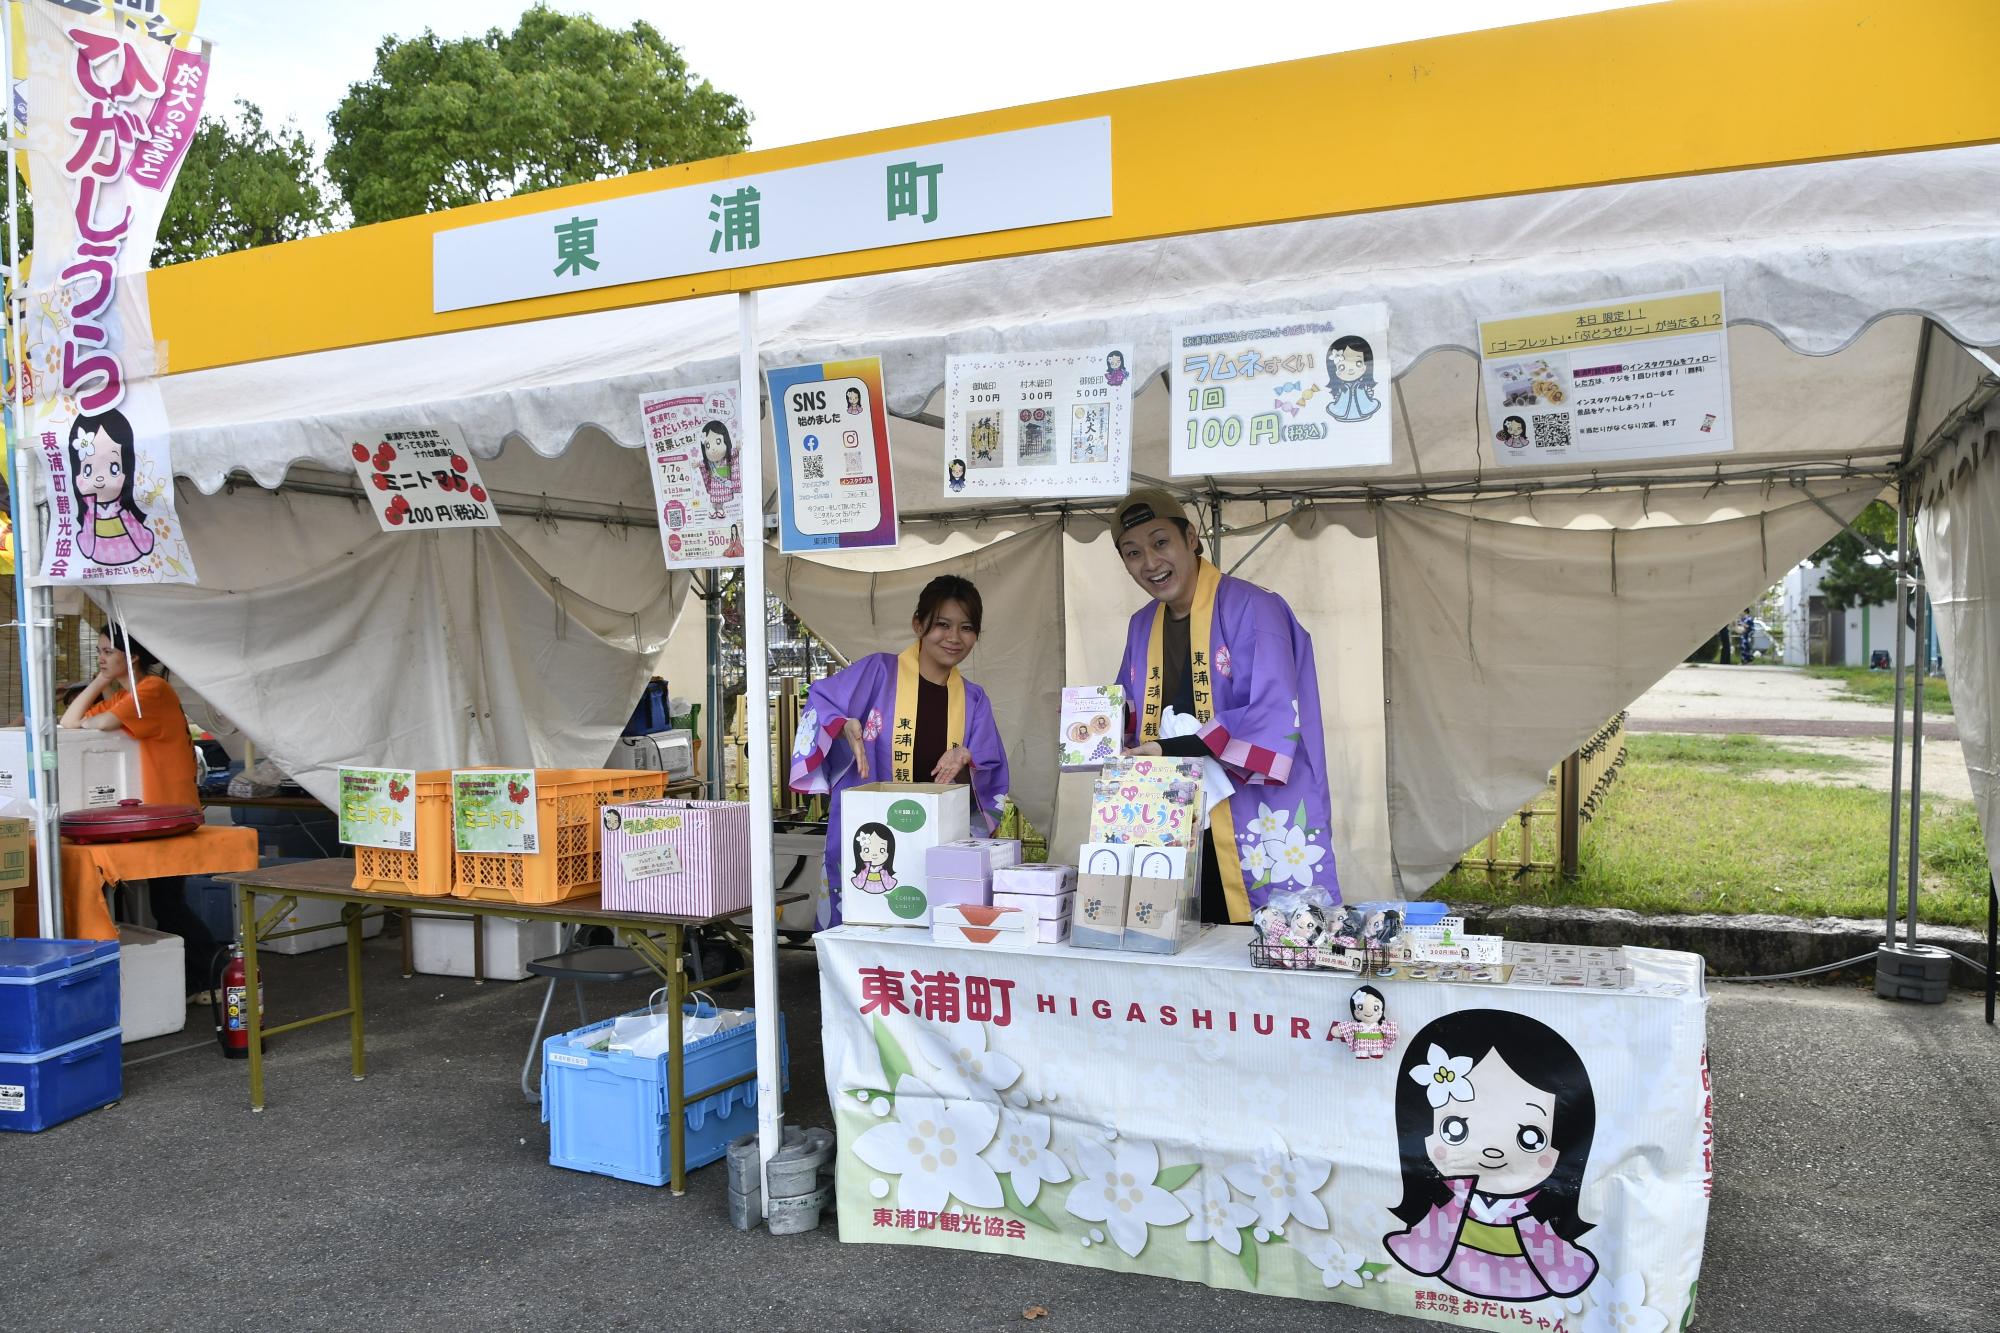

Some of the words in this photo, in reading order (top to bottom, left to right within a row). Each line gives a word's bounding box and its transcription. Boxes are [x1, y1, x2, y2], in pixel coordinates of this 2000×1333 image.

[136, 63, 203, 180] 於大のふるさと
[62, 28, 166, 411] ひがしうら
[553, 161, 944, 277] 東浦町
[1576, 315, 1597, 327] 本日
[1184, 350, 1315, 382] ラムネすくい
[969, 393, 1000, 403] 300円
[1021, 392, 1053, 401] 300円
[1076, 388, 1108, 397] 500円
[972, 382, 997, 391] 御城印
[1188, 386, 1225, 411] 1回
[1576, 389, 1676, 407] インスタグラムをフォローして
[793, 390, 827, 413] SNS
[649, 412, 677, 426] 東浦町の
[797, 413, 841, 427] 始めました
[381, 468, 467, 492] ミニトマト
[40, 431, 73, 577] 東浦町観光協会
[105, 566, 154, 576] おだいちゃん
[894, 717, 914, 783] 東浦町観
[347, 803, 403, 827] ミニトマト
[464, 809, 525, 829] ミニトマト
[1097, 802, 1184, 829] ひがしうら
[858, 966, 1016, 1028] 東浦町
[1036, 992, 1348, 1043] HIGASHIURA
[872, 1207, 1027, 1241] 東浦町観光協会
[1415, 1290, 1459, 1306] 家康の母
[1415, 1301, 1459, 1315] 於大の方
[1462, 1299, 1569, 1333] おだいちゃん
